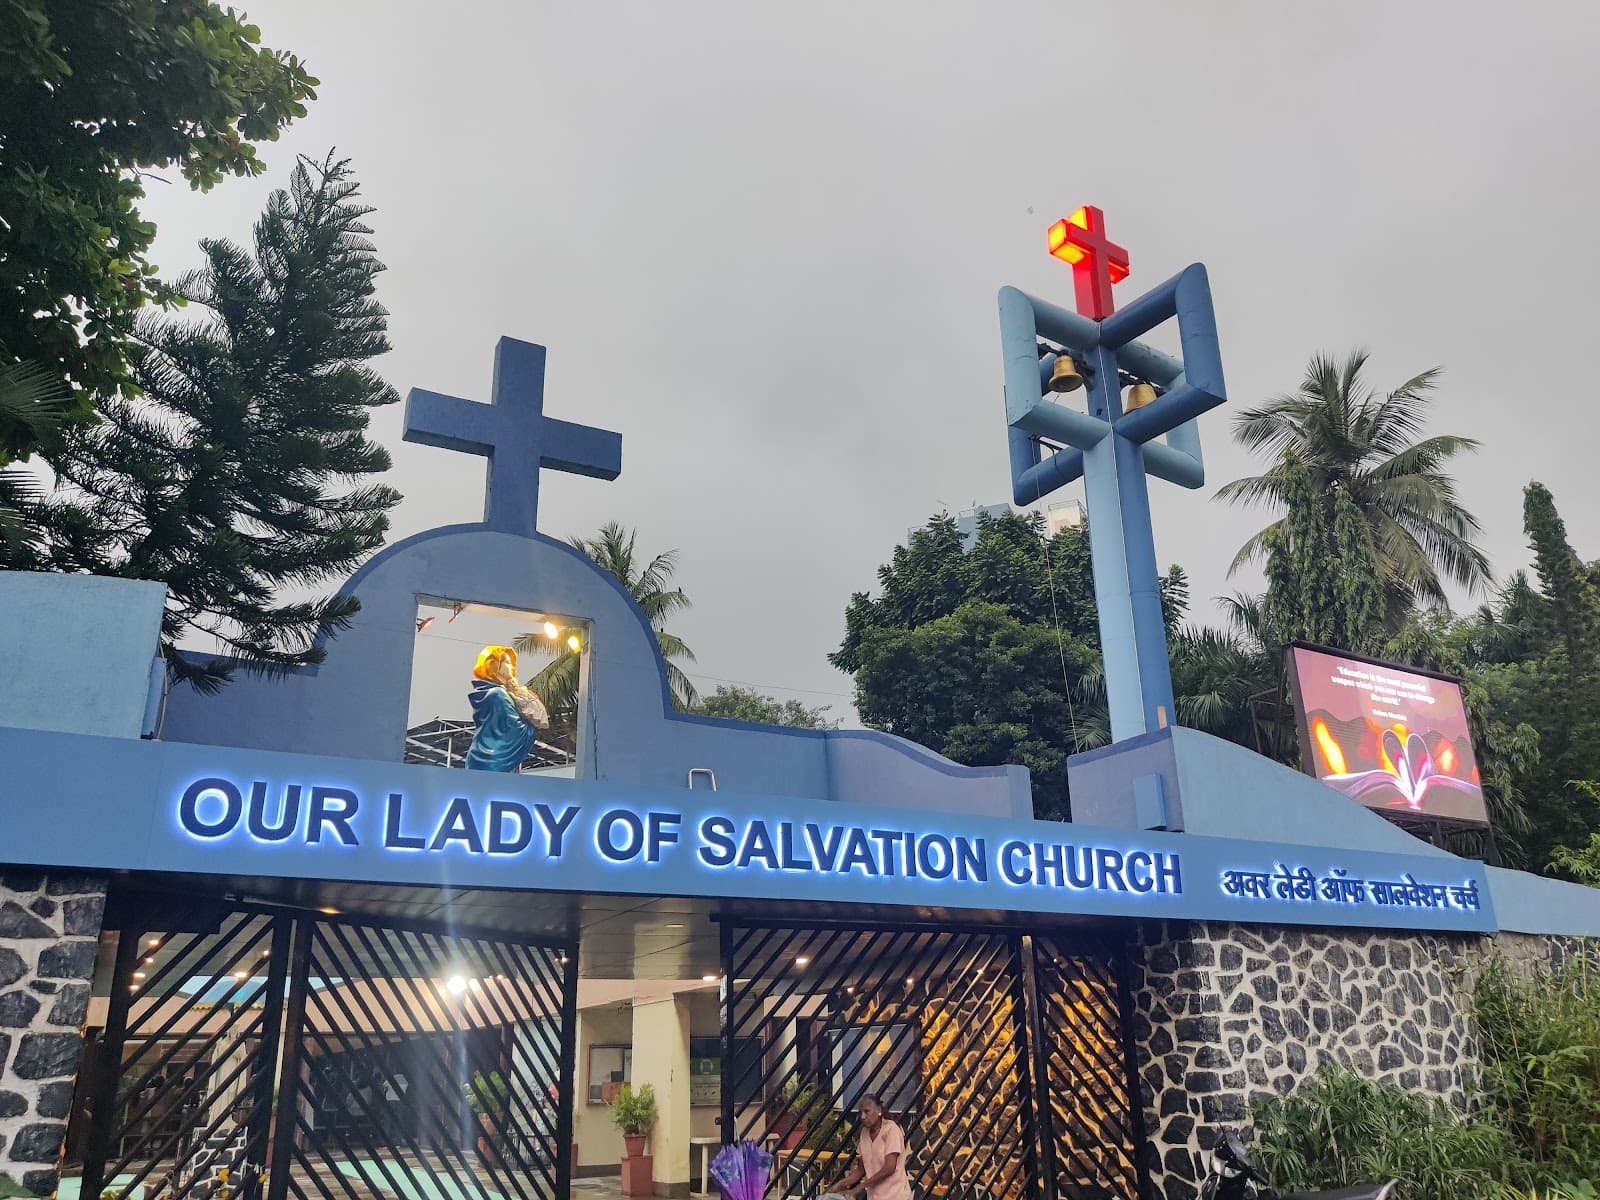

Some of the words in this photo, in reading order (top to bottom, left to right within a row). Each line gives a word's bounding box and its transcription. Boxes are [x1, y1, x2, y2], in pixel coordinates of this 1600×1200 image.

[179, 777, 359, 845] OUR
[385, 793, 581, 857] LADY
[597, 810, 682, 863] OF
[698, 816, 988, 882] SALVATION
[1000, 840, 1183, 894] CHURCH
[1223, 871, 1271, 899] अवर
[1273, 863, 1316, 900] लेडी
[1321, 869, 1364, 903] ऑफ
[1368, 873, 1449, 908] सालवेशन
[1449, 879, 1481, 910] चर्च
